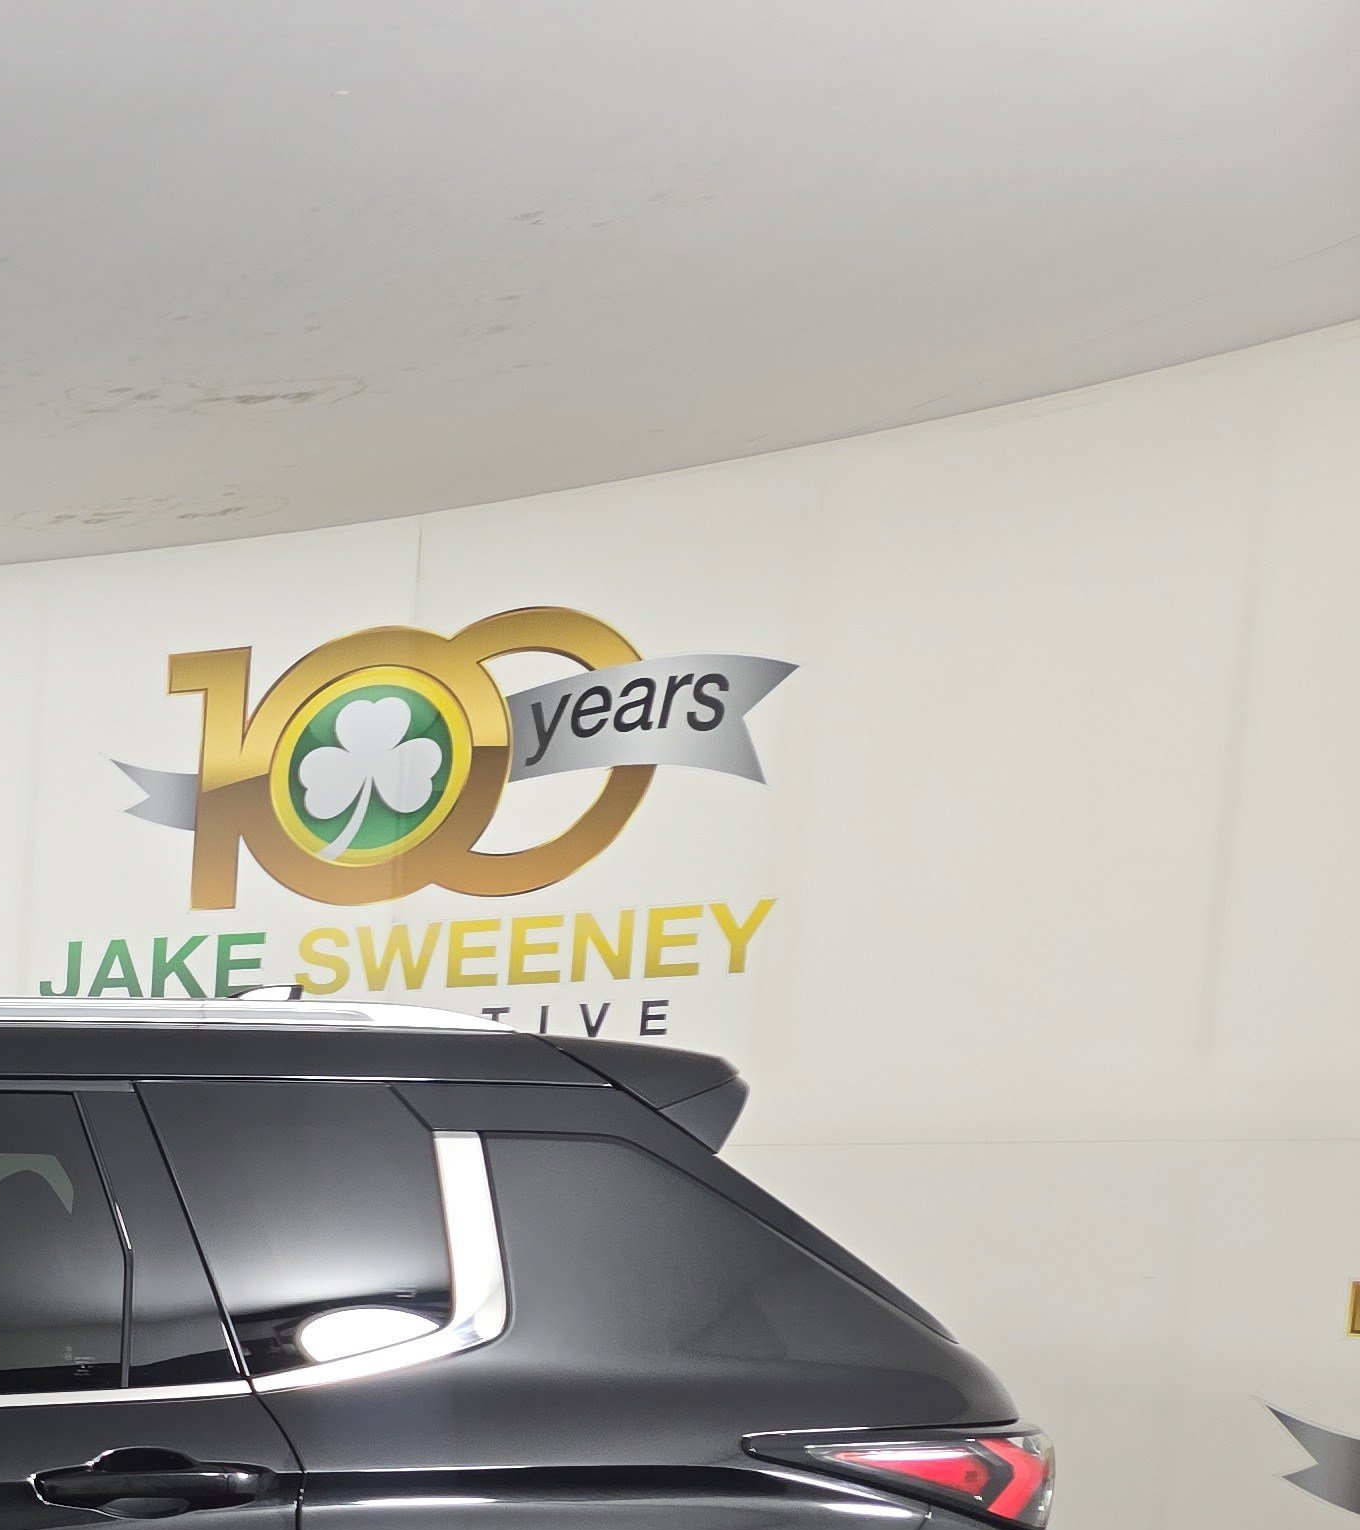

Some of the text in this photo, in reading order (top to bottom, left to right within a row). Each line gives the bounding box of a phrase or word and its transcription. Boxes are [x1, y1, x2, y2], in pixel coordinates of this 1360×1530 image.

[525, 671, 729, 766] years
[39, 898, 777, 998] JAKE SWEENEY
